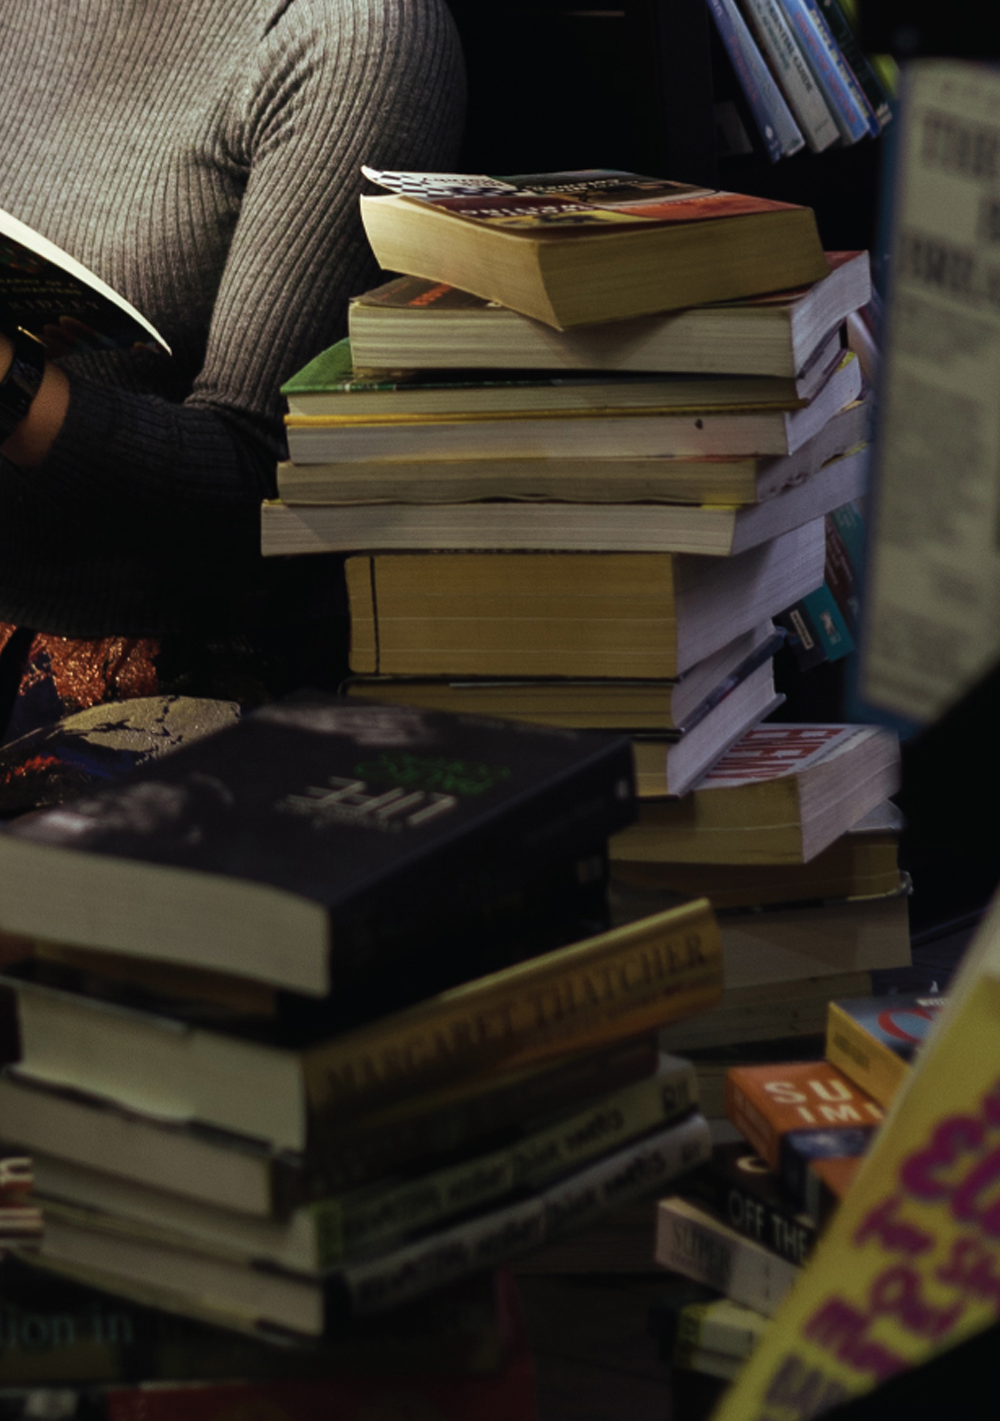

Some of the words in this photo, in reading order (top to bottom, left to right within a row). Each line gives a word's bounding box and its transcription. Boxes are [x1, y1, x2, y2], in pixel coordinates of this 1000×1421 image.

[791, 55, 814, 92] GUIDE
[525, 931, 709, 1028] THATCHER
[728, 1189, 766, 1240] OFF
[769, 1212, 808, 1266] THE
[93, 1300, 134, 1346] in
